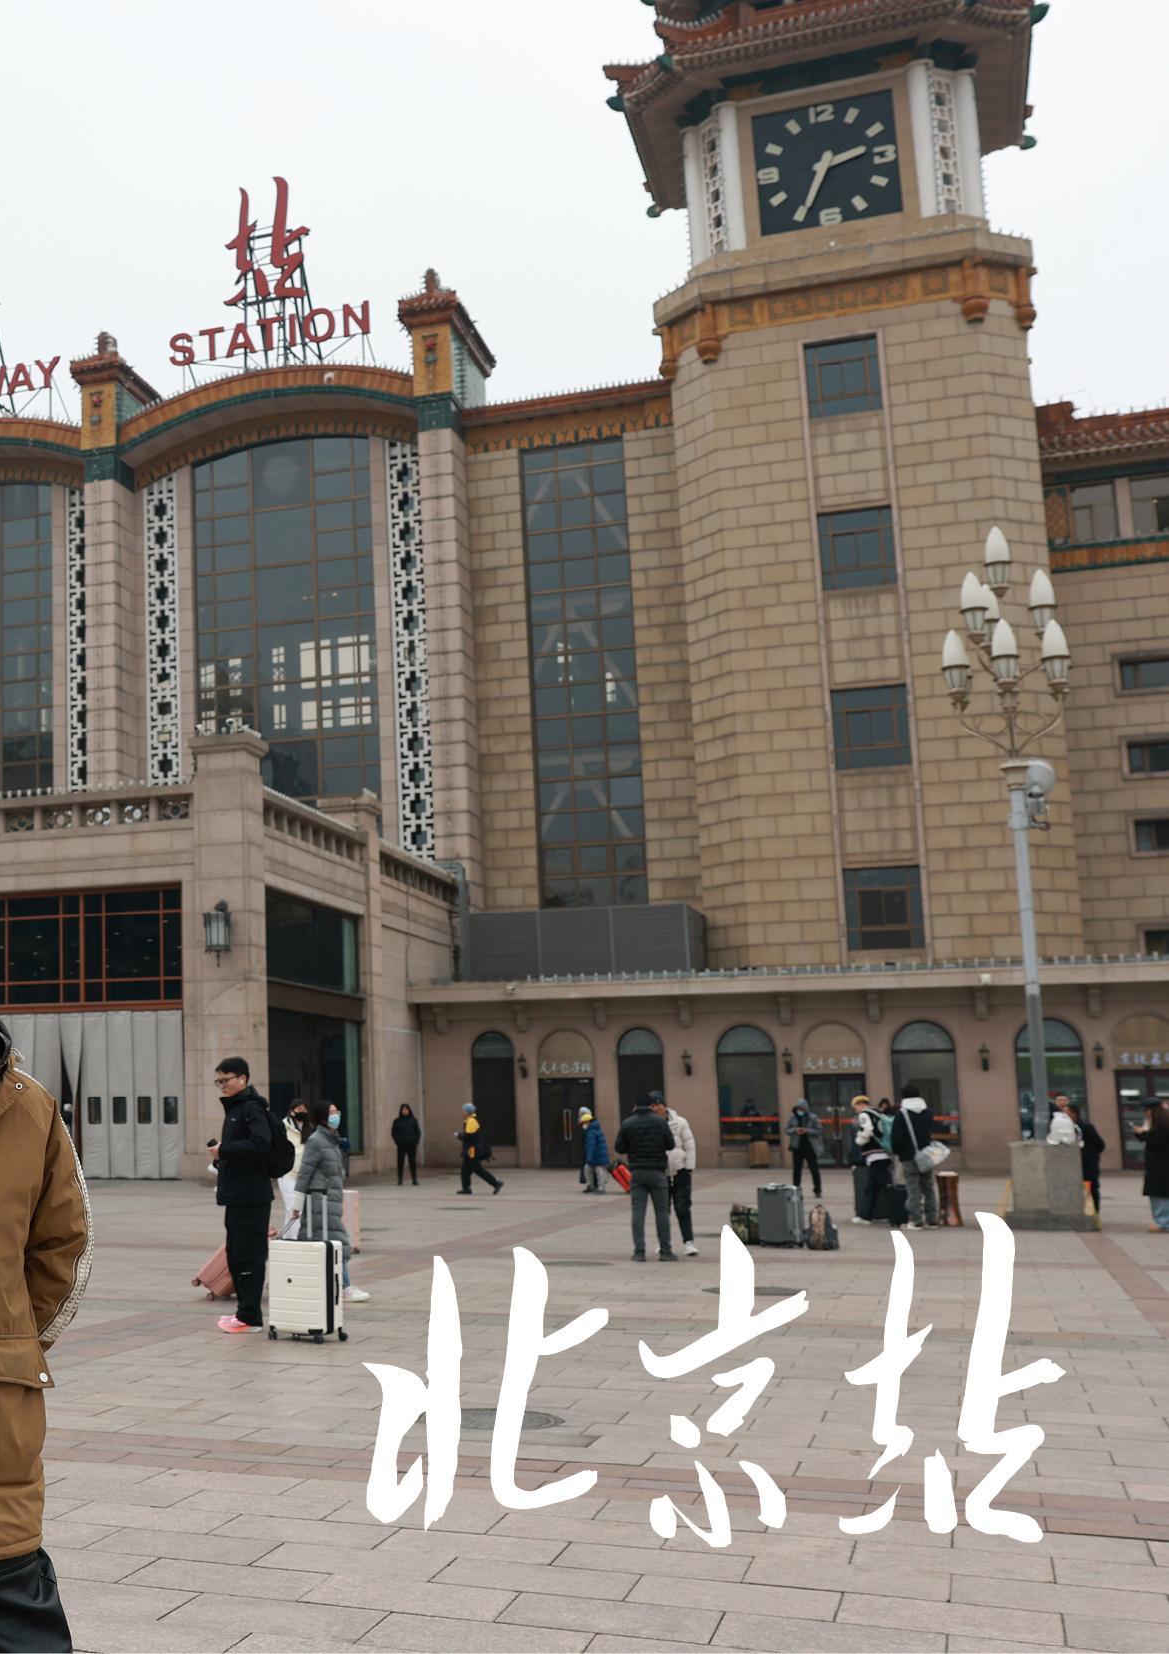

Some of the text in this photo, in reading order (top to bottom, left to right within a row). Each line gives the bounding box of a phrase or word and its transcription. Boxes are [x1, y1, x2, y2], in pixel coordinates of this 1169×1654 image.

[808, 104, 835, 124] 12
[872, 145, 897, 164] 3
[757, 167, 779, 185] 9
[818, 207, 843, 226] 6
[169, 300, 371, 366] STATION
